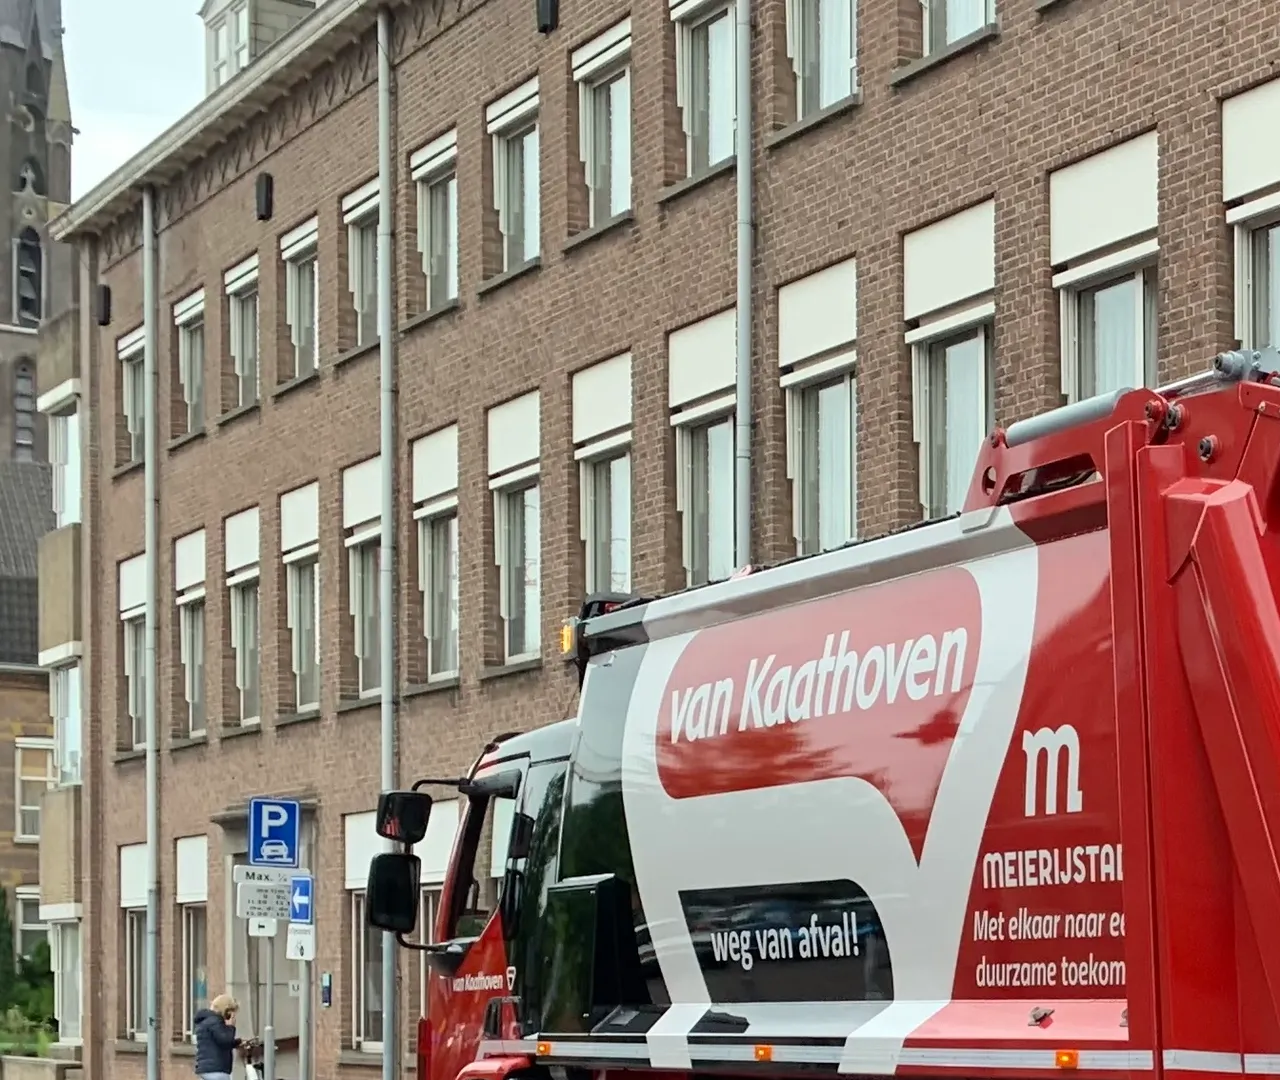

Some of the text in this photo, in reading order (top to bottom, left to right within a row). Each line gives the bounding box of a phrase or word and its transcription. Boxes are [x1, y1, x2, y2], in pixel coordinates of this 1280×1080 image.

[670, 627, 968, 744] van Kaathoven
[261, 804, 288, 838] P
[245, 871, 273, 882] Max.
[710, 911, 859, 970] weg van afval!
[973, 910, 1005, 941] Met
[1008, 908, 1061, 940] elkaar
[1064, 912, 1105, 938] naar
[976, 952, 1126, 987] duurzame toekom
